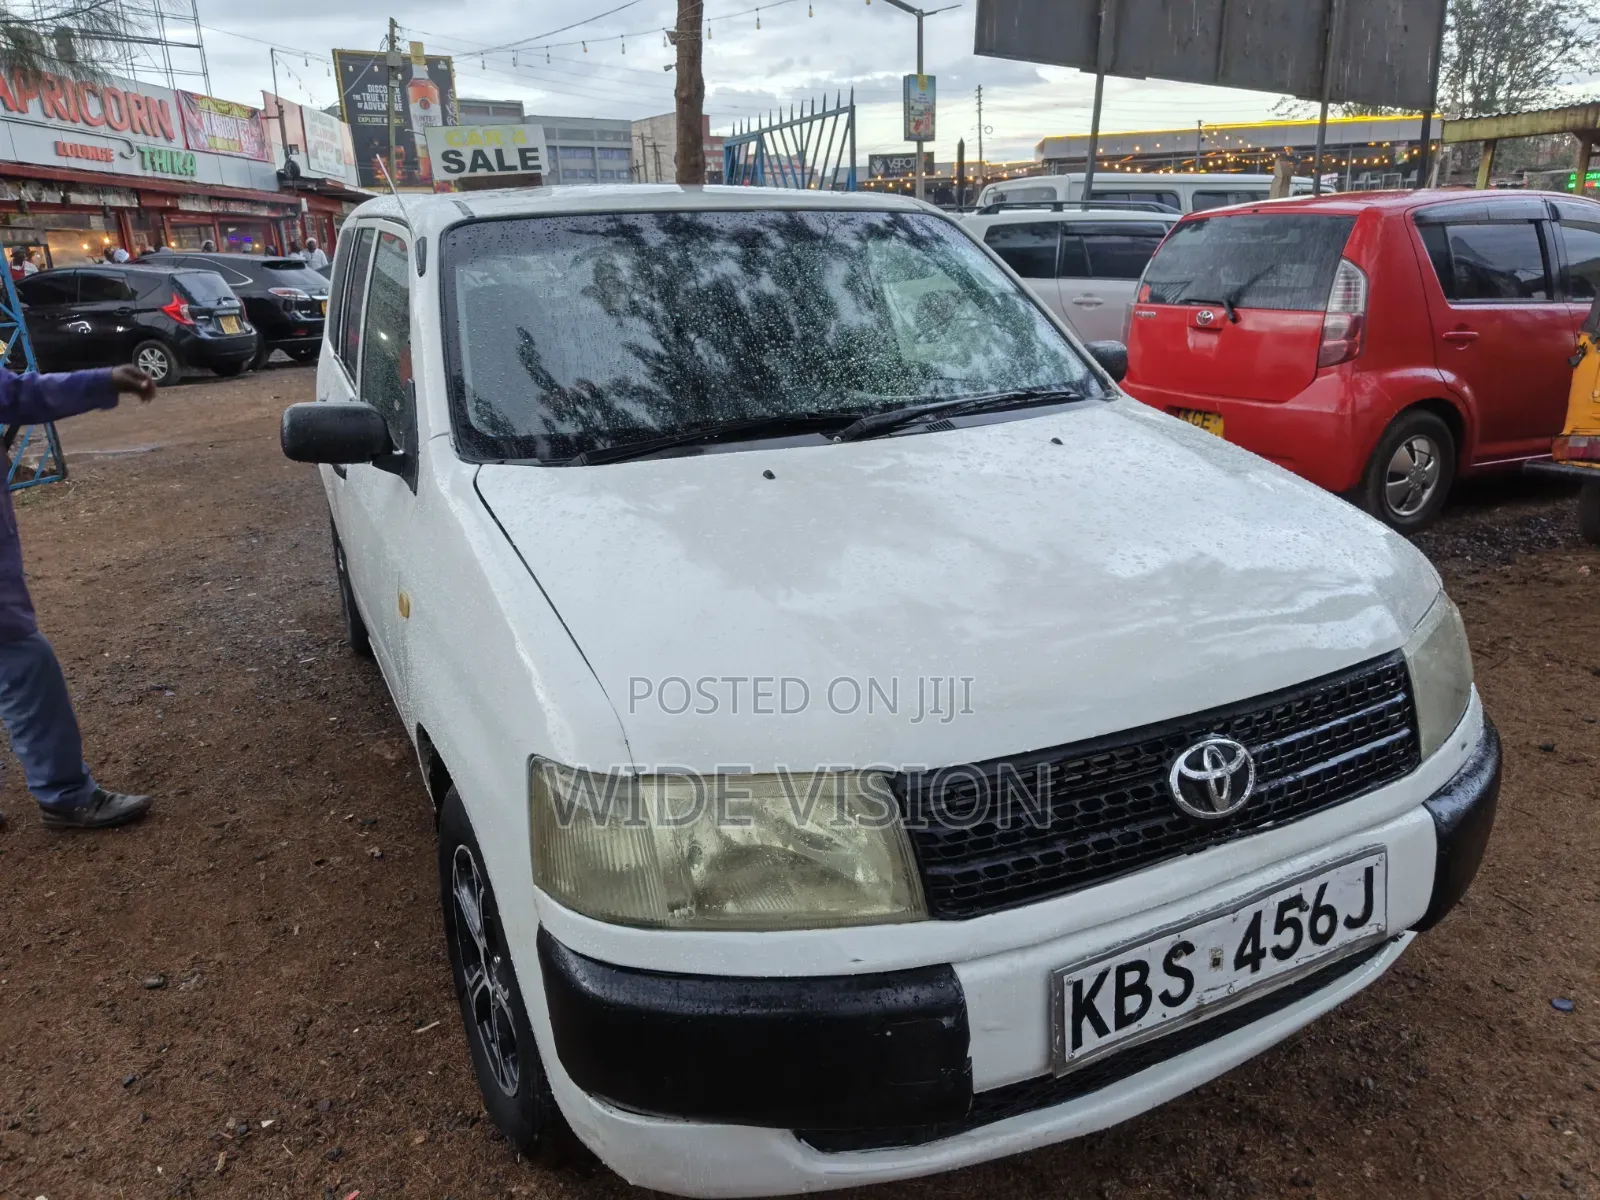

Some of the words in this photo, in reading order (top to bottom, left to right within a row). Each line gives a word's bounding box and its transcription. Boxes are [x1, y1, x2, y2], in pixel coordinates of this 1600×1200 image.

[361, 92, 380, 102] TRUE
[380, 94, 402, 103] TATE
[363, 101, 404, 112] ADVENRE
[357, 116, 383, 124] EXPLORE
[445, 130, 503, 148] CAR
[512, 129, 528, 145] 4
[54, 140, 115, 163] LOUNGE
[136, 145, 197, 177] THIKA
[441, 147, 543, 174] SALE
[1070, 940, 1197, 1051] KBS
[1233, 866, 1375, 974] 456J
